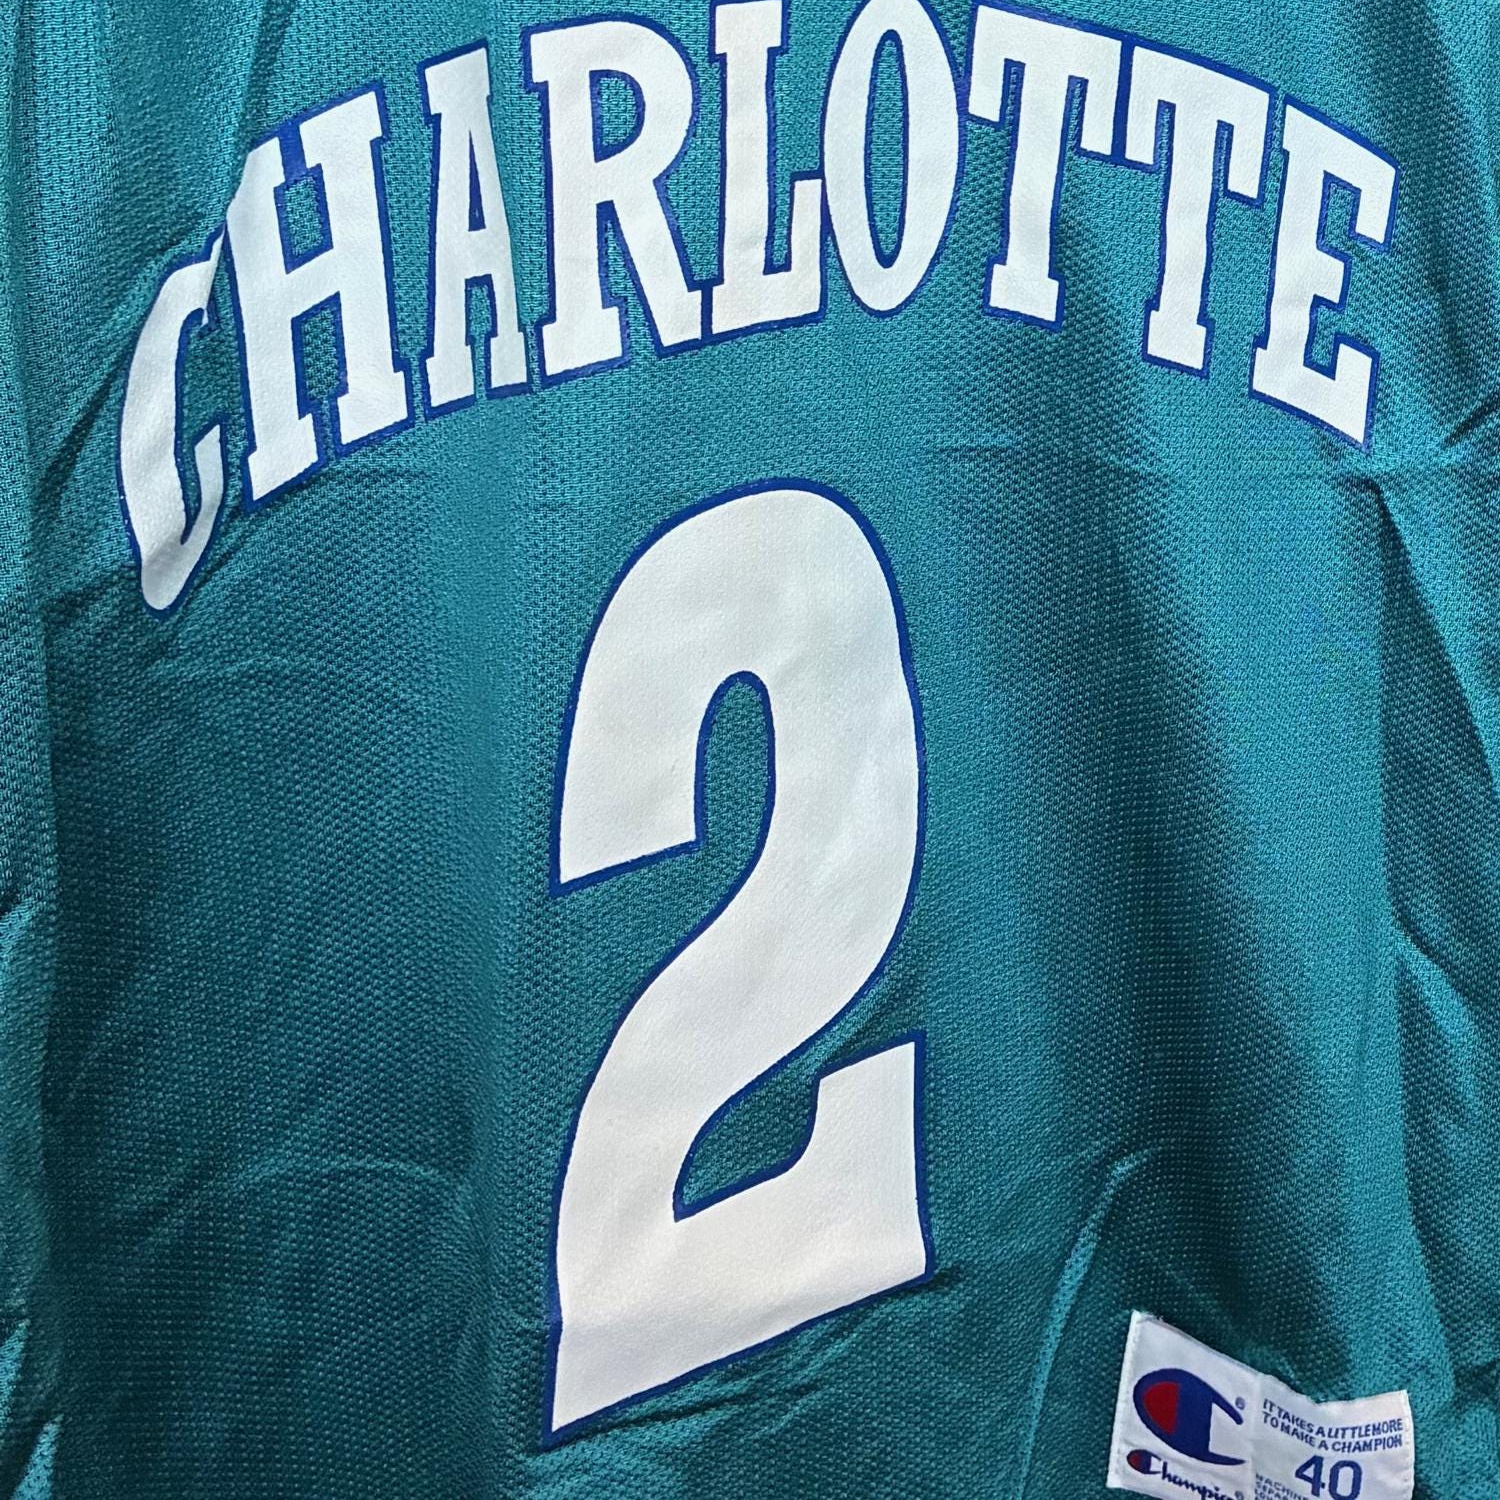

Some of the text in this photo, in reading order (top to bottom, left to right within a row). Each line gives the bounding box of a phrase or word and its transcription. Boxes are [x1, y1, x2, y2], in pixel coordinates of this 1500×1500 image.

[540, 477, 934, 1452] 2
[1262, 1410, 1403, 1454] TO MAKE A CHAMPION
[1263, 1398, 1277, 1413] IT
[1277, 1405, 1315, 1433] TAKES
[1315, 1425, 1326, 1438] A
[1294, 1454, 1363, 1500] 40
